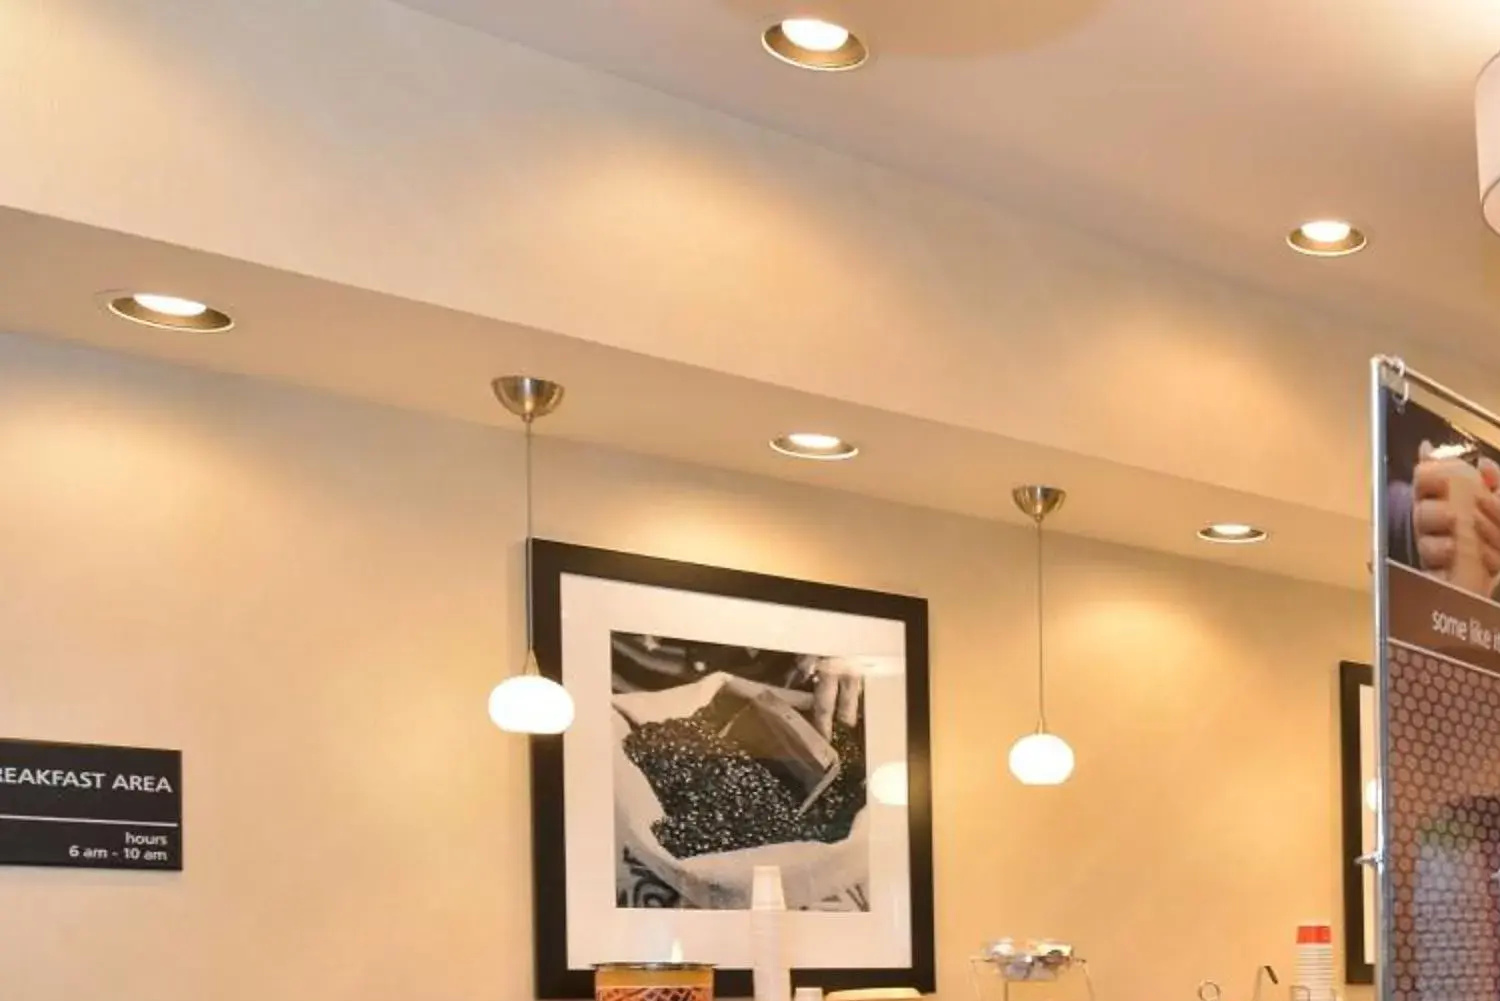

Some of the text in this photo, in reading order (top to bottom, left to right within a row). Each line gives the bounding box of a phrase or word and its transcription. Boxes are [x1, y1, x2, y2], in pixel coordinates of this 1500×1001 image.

[1431, 610, 1467, 641] some
[1469, 617, 1492, 650] like
[0, 767, 173, 793] EAKFAST AREA
[125, 831, 168, 845] hours
[68, 844, 80, 858] 6
[82, 847, 108, 859] am
[123, 847, 141, 860] 10
[143, 850, 168, 861] am
